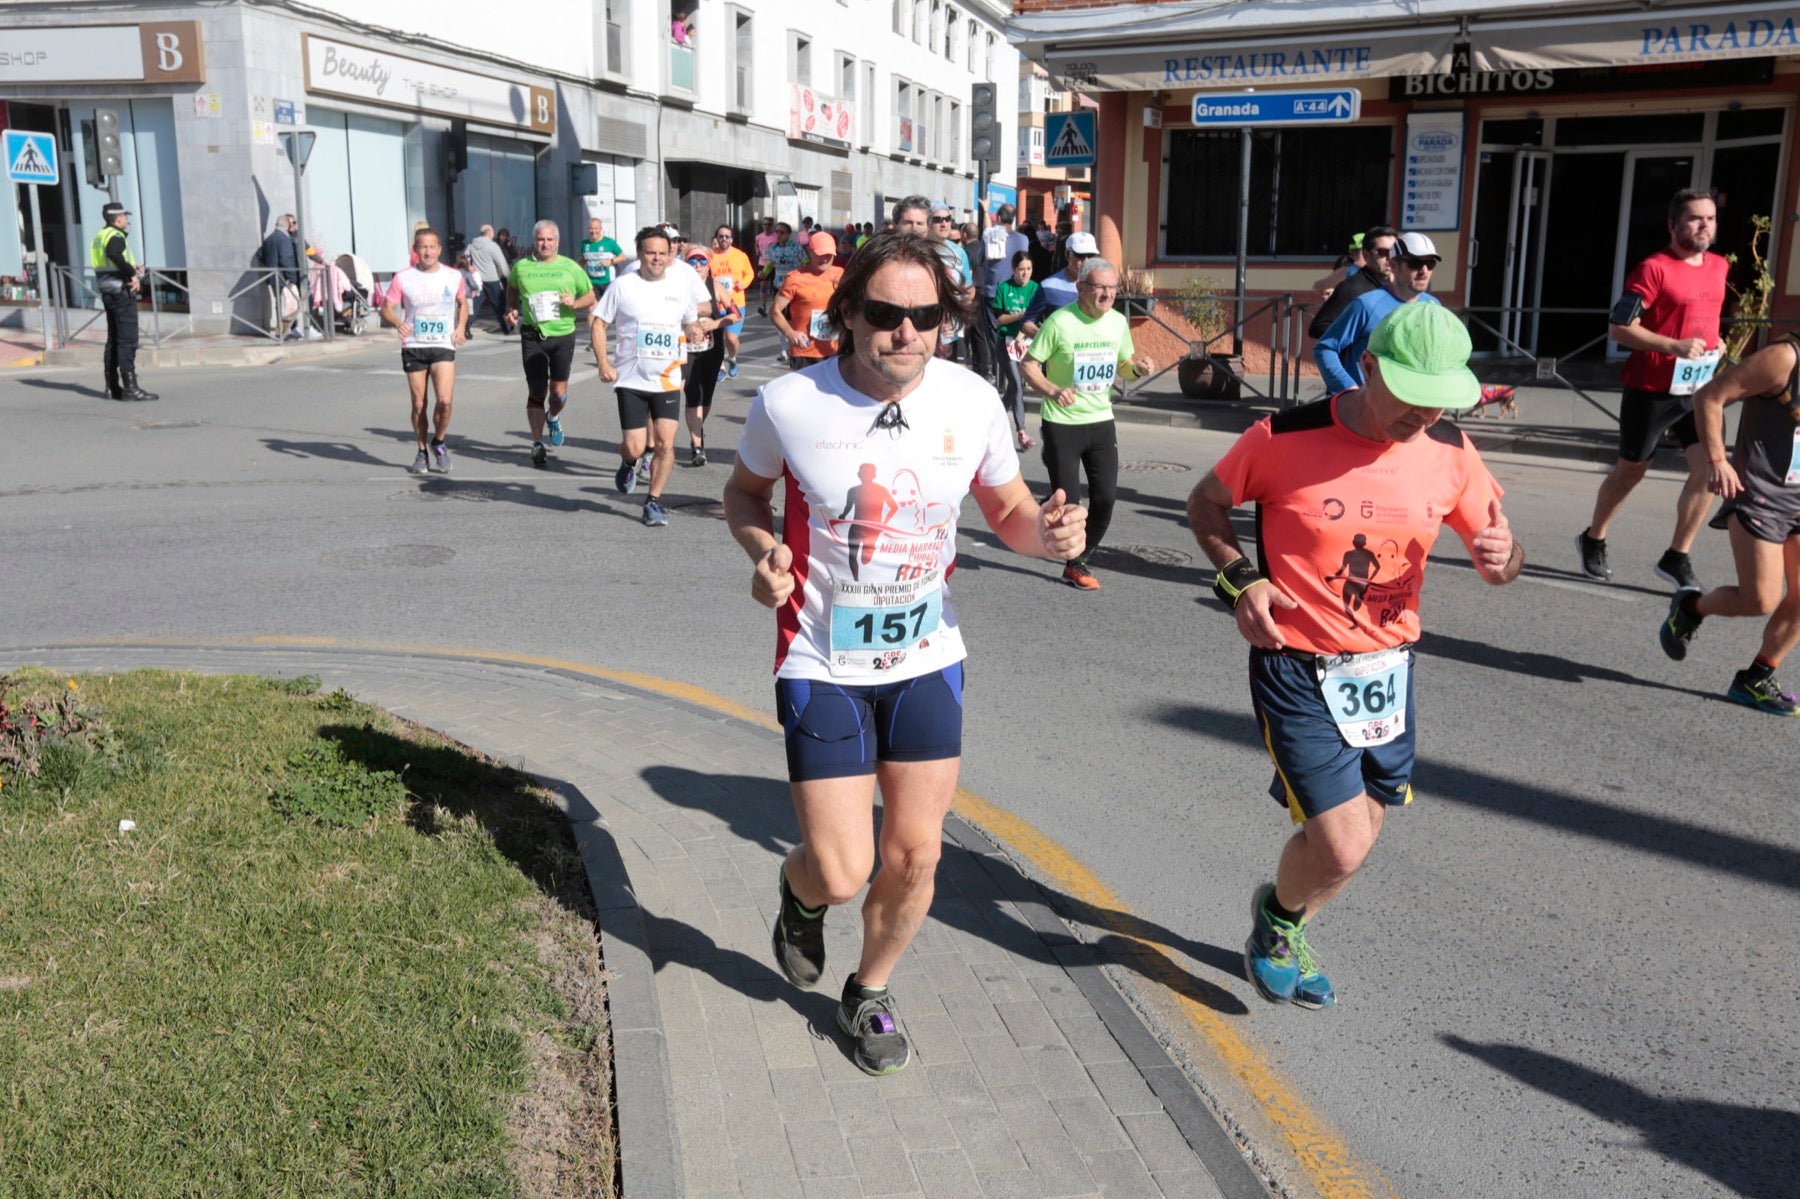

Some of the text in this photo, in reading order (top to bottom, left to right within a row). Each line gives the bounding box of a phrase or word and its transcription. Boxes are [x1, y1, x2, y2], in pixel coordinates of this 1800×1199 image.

[1639, 17, 1800, 56] PARADA
[156, 33, 183, 71] B
[1164, 46, 1371, 83] RESTAURANTE
[322, 46, 391, 95] Beauty
[1404, 69, 1555, 95] BICHITOS
[537, 94, 549, 124] B
[1197, 103, 1260, 117] Granada
[420, 321, 444, 333] 979
[645, 332, 672, 348] 648
[1077, 363, 1114, 380] 1048
[1681, 364, 1711, 381] 817
[879, 543, 907, 554] MEDIA
[863, 583, 884, 595] GRAN
[884, 583, 912, 595] PREMIO
[854, 601, 928, 644] 157
[1338, 672, 1396, 716] 364
